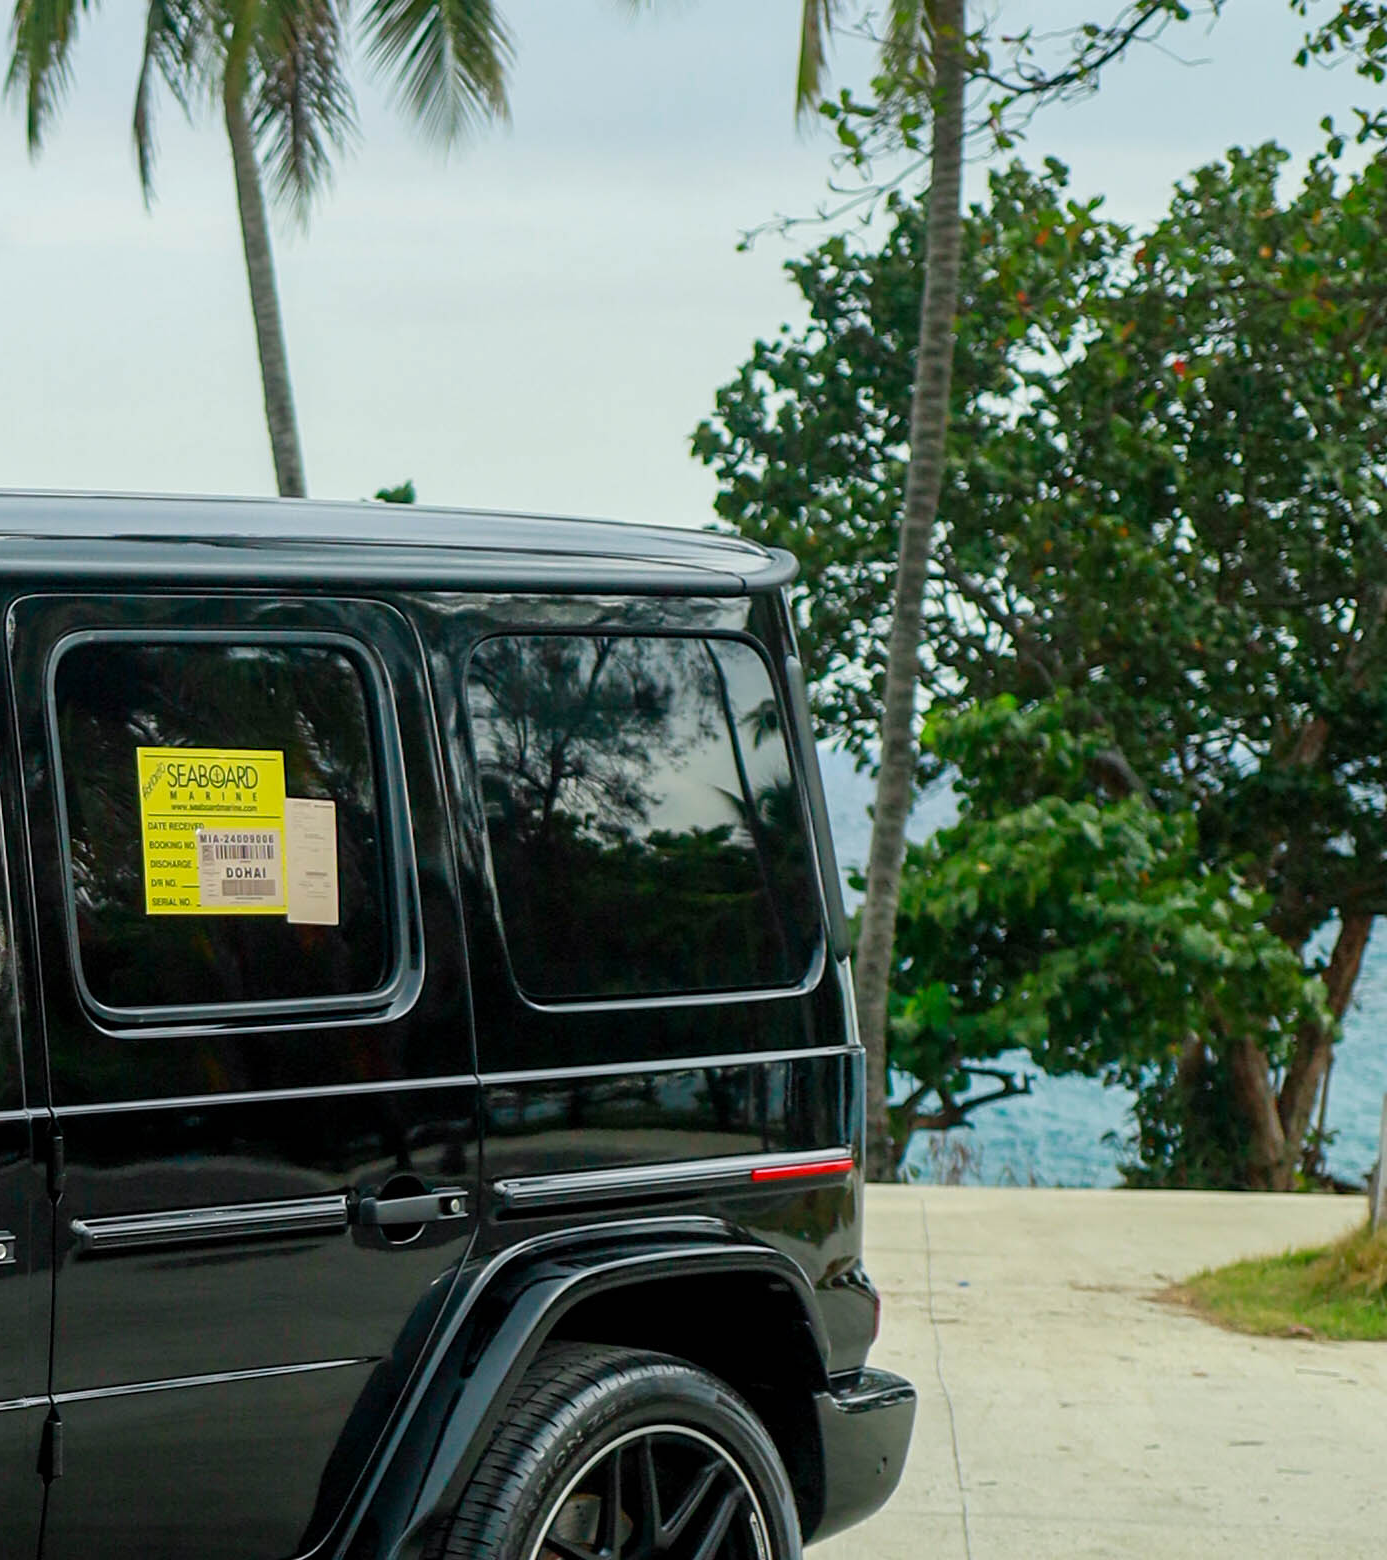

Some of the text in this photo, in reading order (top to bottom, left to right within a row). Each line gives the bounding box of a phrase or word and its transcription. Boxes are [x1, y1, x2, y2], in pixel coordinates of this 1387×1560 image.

[166, 762, 259, 789] SEABOARD
[169, 790, 259, 802] MARINE
[147, 821, 205, 832] DATE RECEIVED
[149, 840, 183, 850] BOOKING
[150, 859, 193, 869] DISCHARGE
[226, 867, 267, 879] DOHAI
[151, 897, 178, 907] SERIAL
